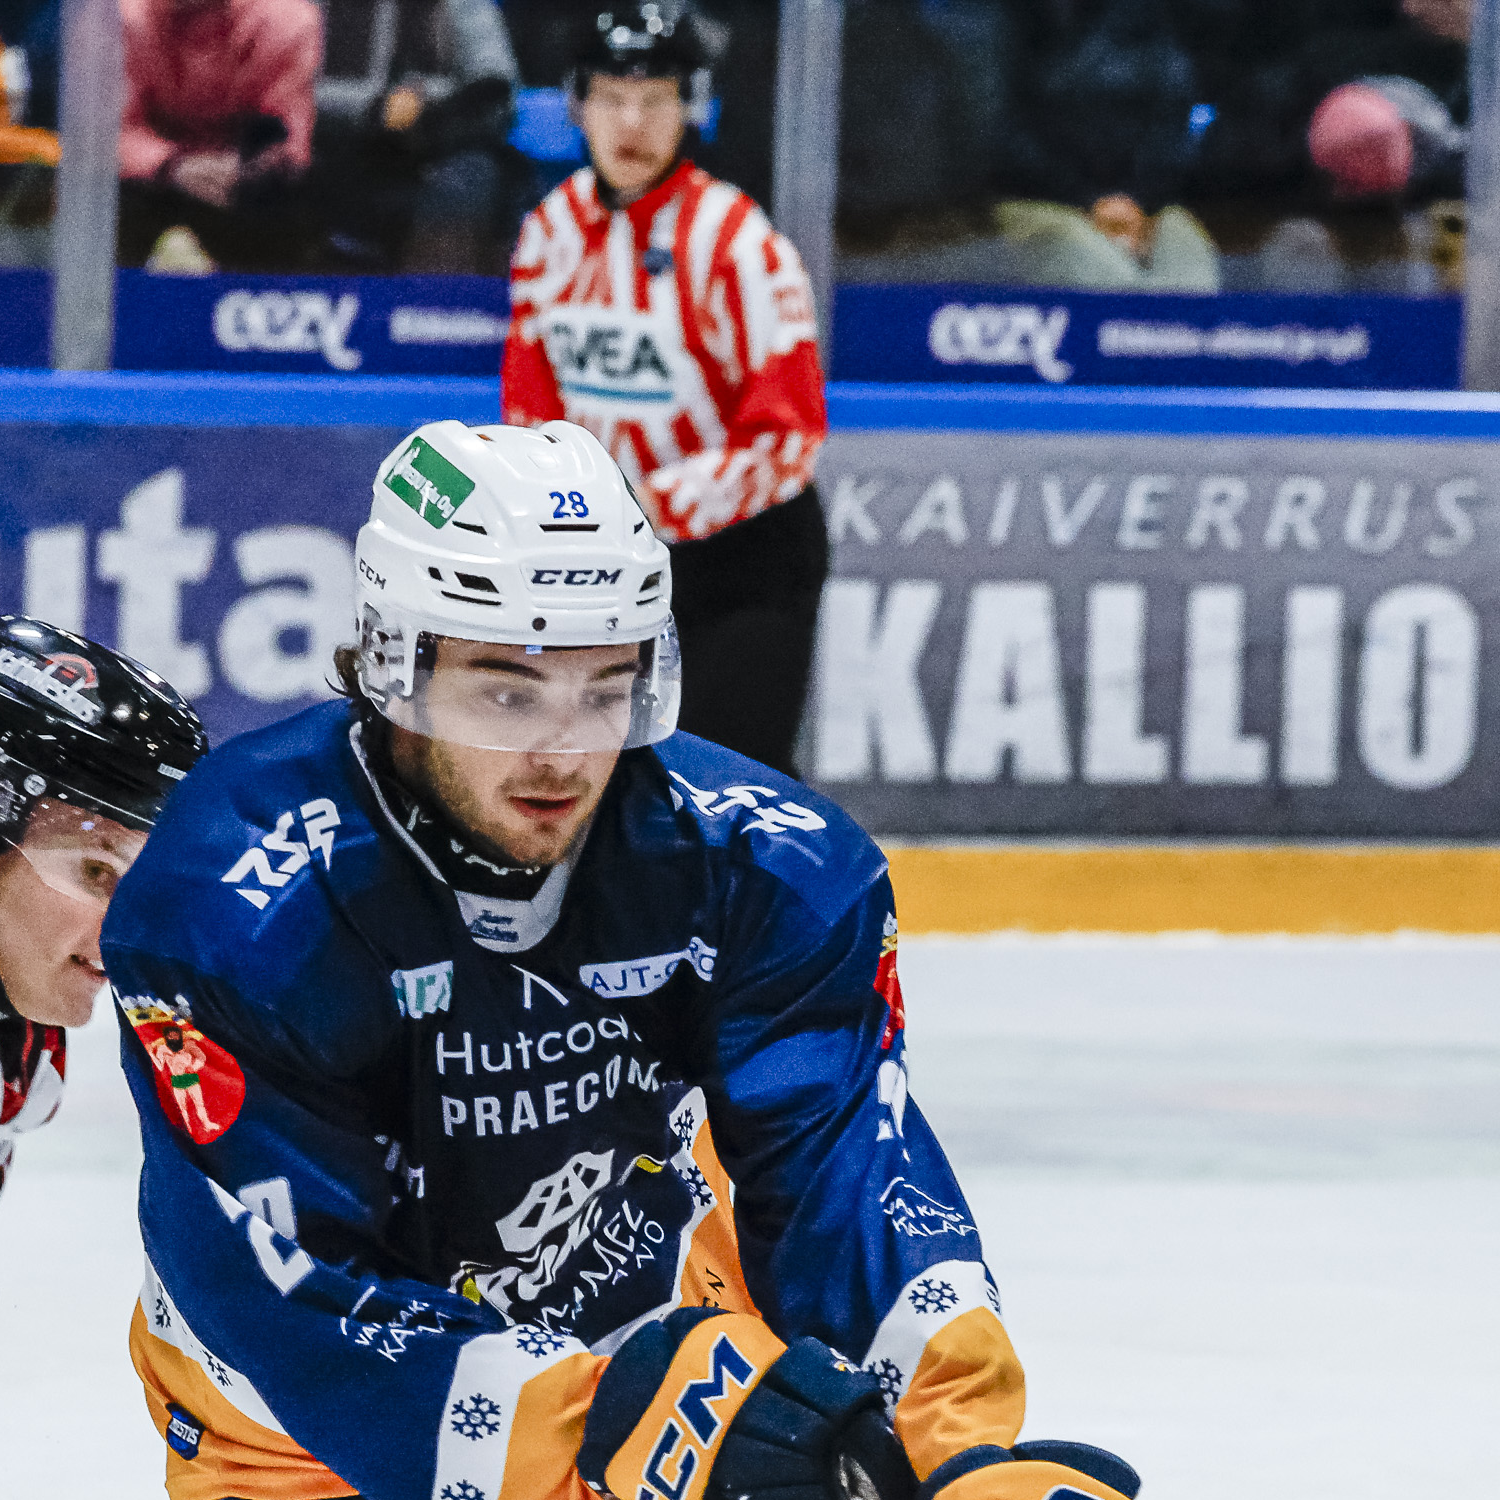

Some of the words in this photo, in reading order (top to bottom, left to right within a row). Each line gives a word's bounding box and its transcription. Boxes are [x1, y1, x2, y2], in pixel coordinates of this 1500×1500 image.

[549, 491, 589, 519] 28
[828, 473, 1488, 557] KAIVERRUS
[359, 558, 387, 590] CCM
[531, 569, 622, 585] CCM
[812, 578, 1480, 791] KALLIO
